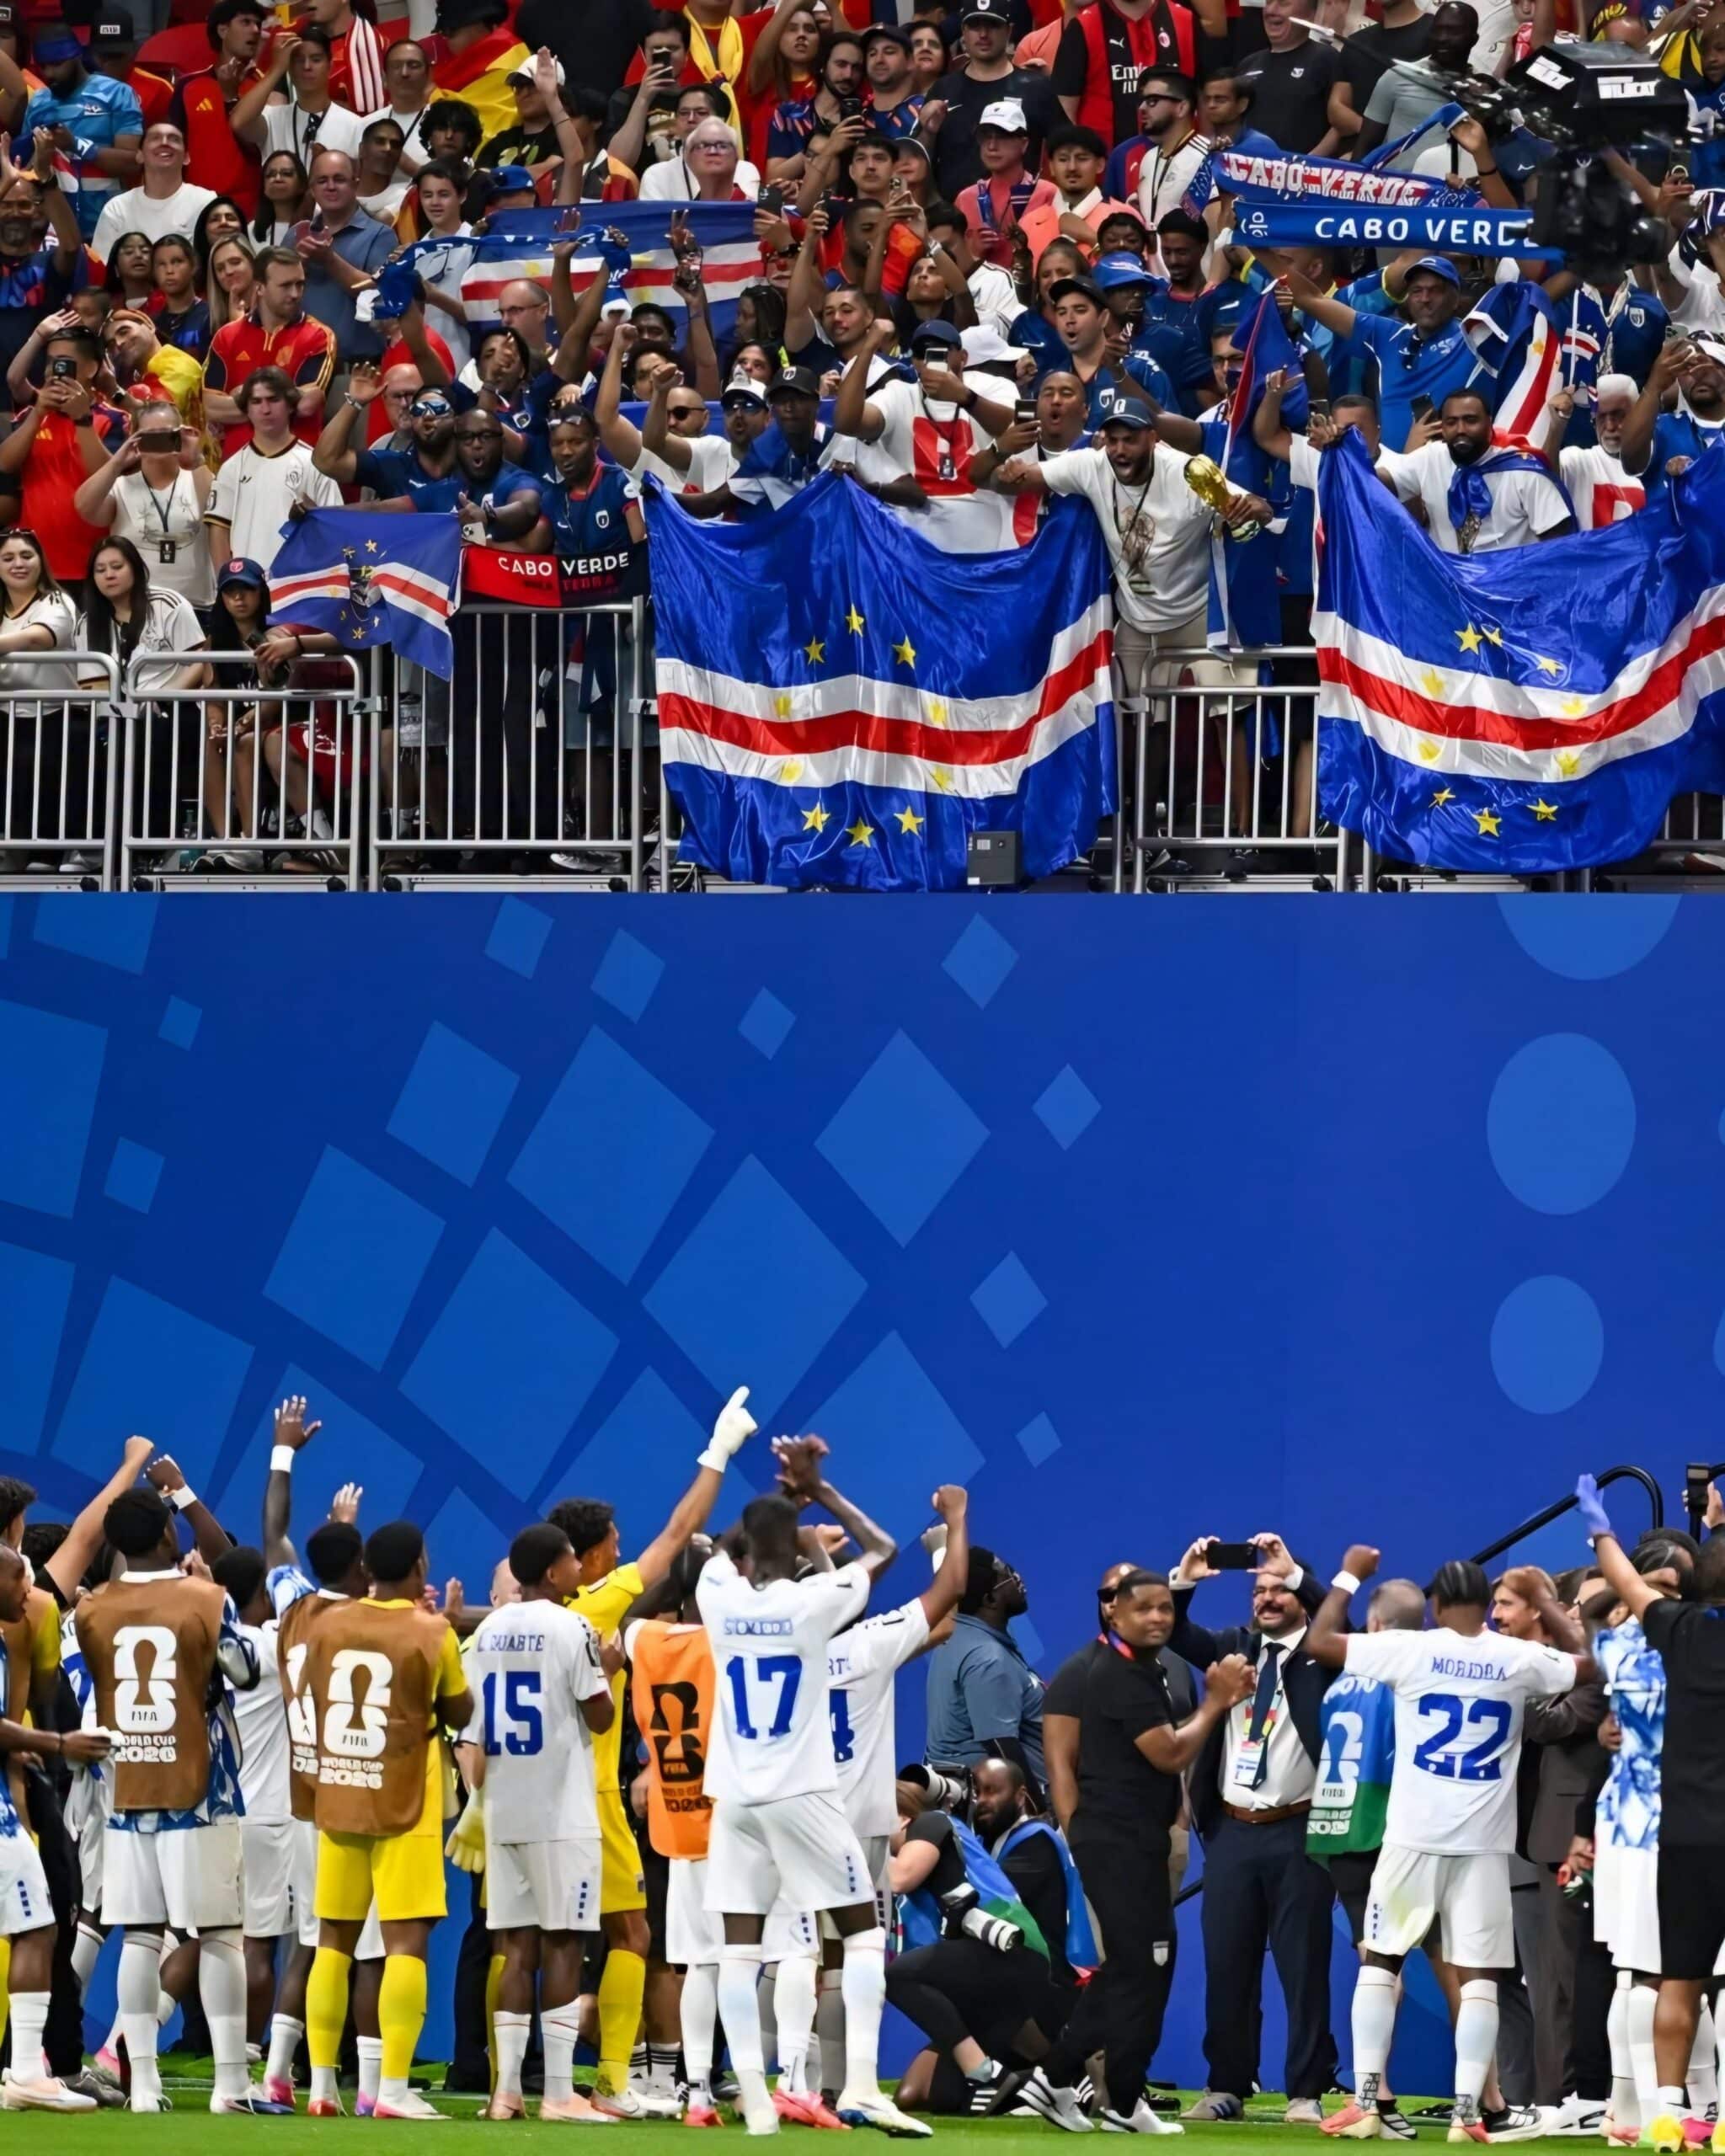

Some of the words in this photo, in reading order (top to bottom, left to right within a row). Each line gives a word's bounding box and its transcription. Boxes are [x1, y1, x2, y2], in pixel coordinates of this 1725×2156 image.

[1315, 217, 1408, 241] CABO
[499, 557, 552, 576] CABO
[562, 552, 628, 575] VERDE
[483, 1671, 543, 1756] 15
[726, 1656, 802, 1739] 17
[1413, 1693, 1512, 1780] 22
